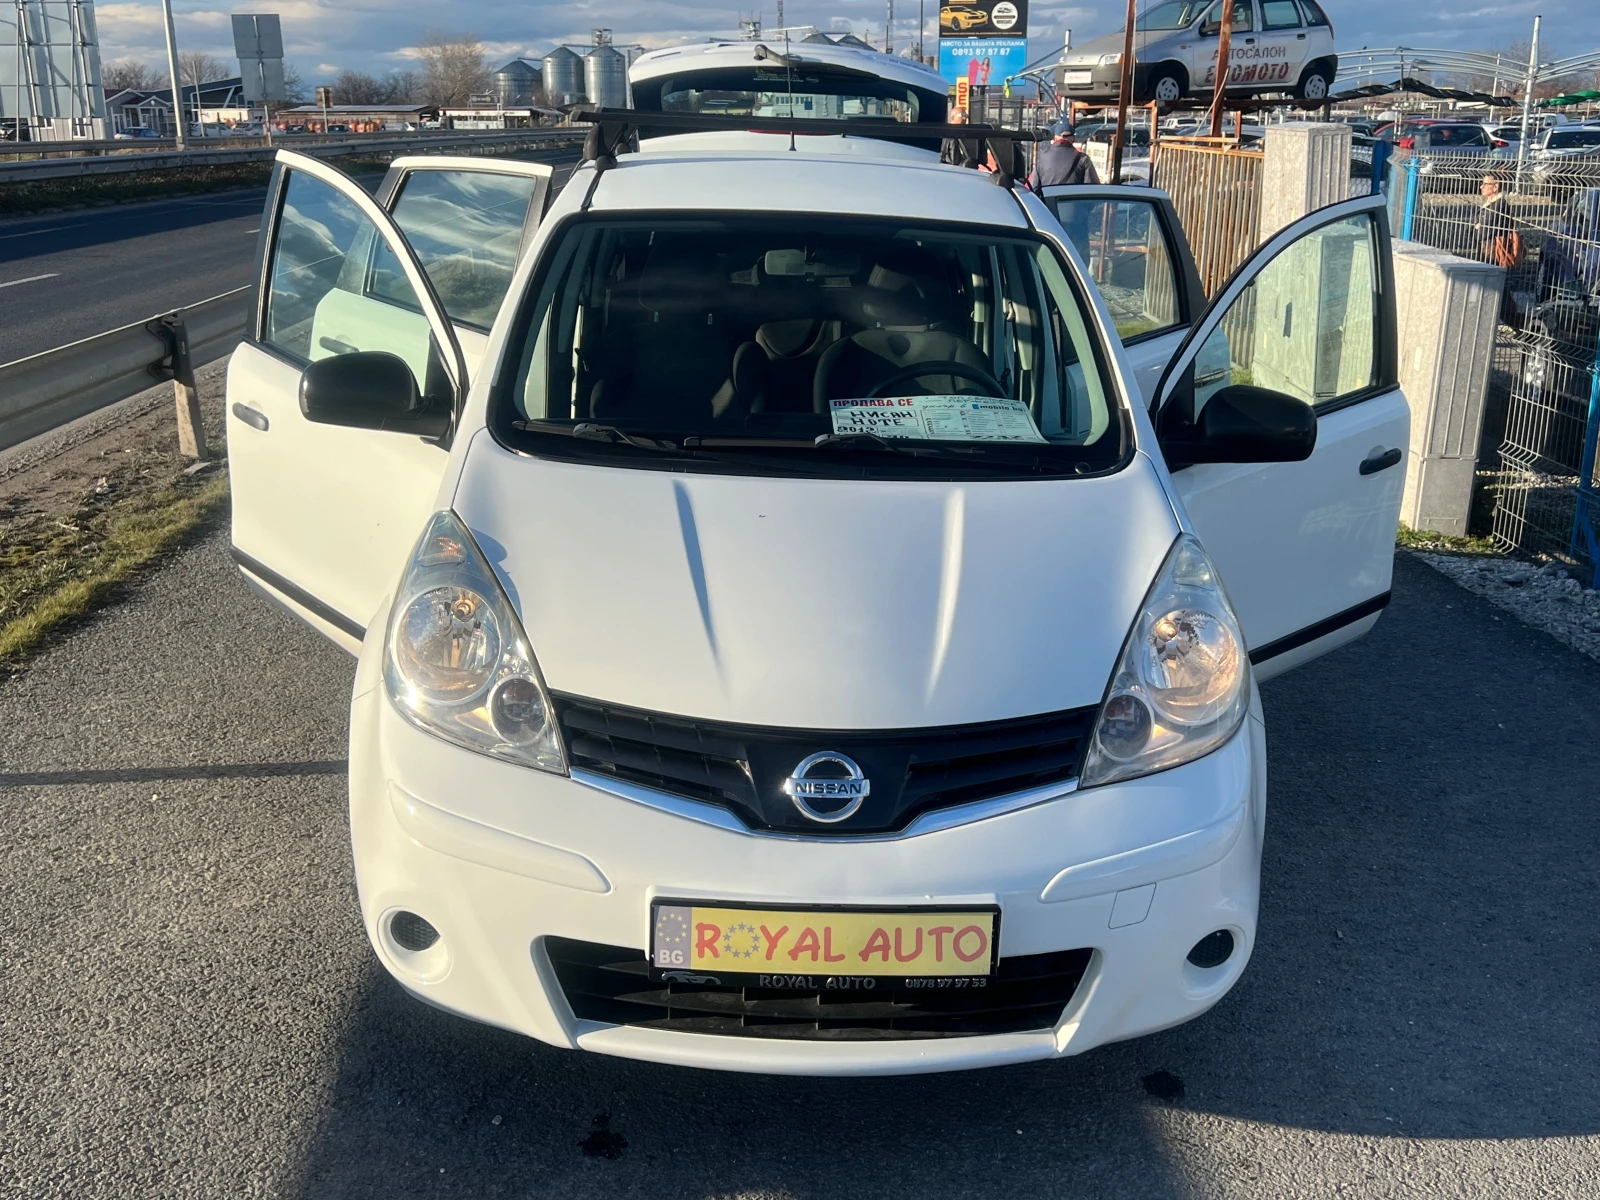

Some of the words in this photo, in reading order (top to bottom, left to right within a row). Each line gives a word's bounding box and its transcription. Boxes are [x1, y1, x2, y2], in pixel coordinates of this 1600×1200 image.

[952, 48, 973, 56] 0893
[975, 48, 986, 56] 87
[987, 48, 998, 56] 87
[1000, 48, 1011, 56] 87
[1212, 46, 1286, 61] АТОСАЛОН
[833, 399, 894, 408] ПРОДАВА
[897, 398, 914, 407] СЕ
[850, 411, 914, 419] НИСАН
[850, 418, 905, 427] НОТЕ
[795, 782, 862, 794] NISSAN
[695, 921, 846, 963] ROYAL
[858, 925, 988, 963] AUTO
[659, 949, 684, 965] BG
[759, 974, 818, 989] ROYAL
[825, 976, 876, 990] AUTO
[905, 978, 935, 989] 0878
[937, 978, 953, 989] 97
[954, 978, 970, 989] 97
